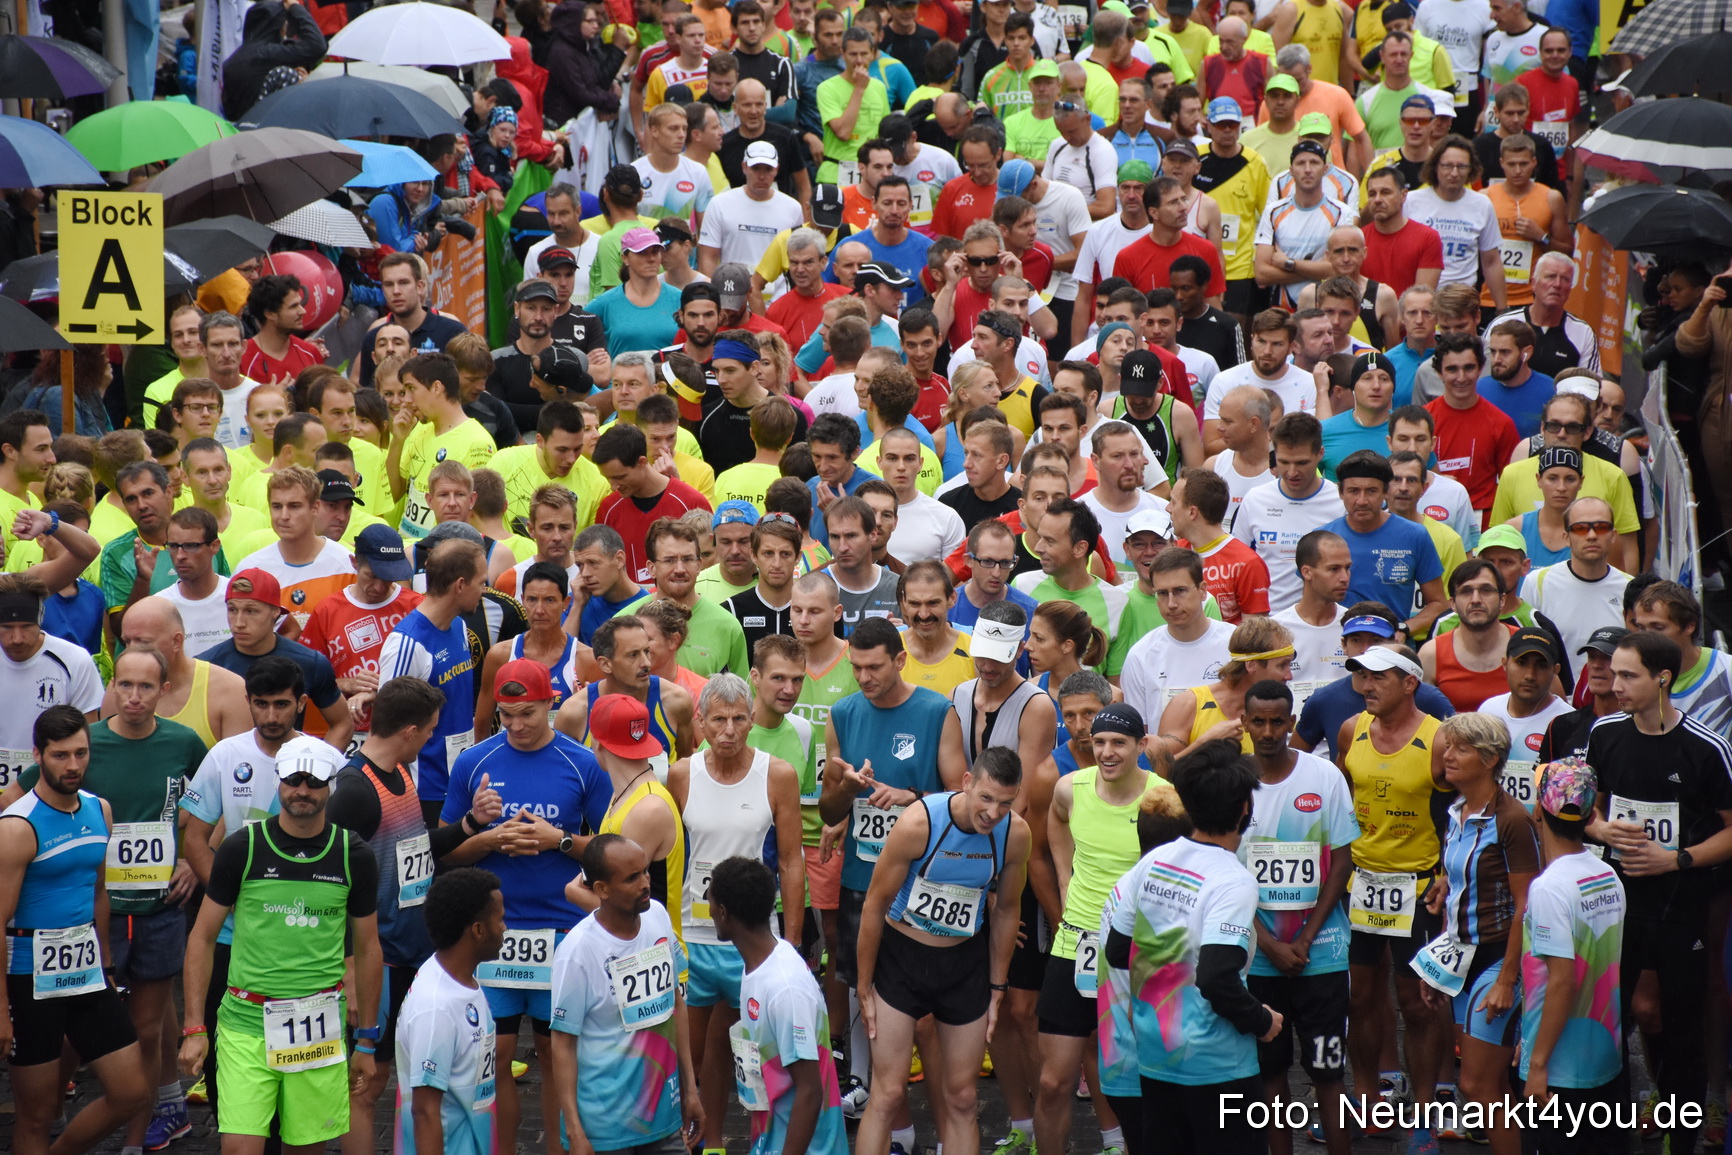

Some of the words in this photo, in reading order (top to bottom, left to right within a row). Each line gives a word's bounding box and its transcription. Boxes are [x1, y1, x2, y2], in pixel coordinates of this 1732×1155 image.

[72, 198, 153, 227] Block
[82, 238, 143, 311] A
[727, 492, 754, 503] Team
[1427, 507, 1447, 518] Hervis
[1298, 799, 1321, 808] Hervis
[118, 838, 164, 865] 620
[1279, 844, 1313, 854] BOCK
[1254, 858, 1315, 884] 2679
[1268, 890, 1301, 901] Mohad
[1363, 885, 1403, 912] 319
[263, 903, 298, 915] SoWiso
[304, 906, 323, 916] Run
[329, 908, 339, 916] Fit
[913, 892, 973, 928] 2685
[1367, 914, 1397, 927] Robert
[42, 939, 96, 973] 2673
[501, 937, 548, 963] 393
[495, 966, 535, 980] Andreas
[1424, 959, 1441, 980] Petra
[55, 974, 87, 989] Roland
[622, 961, 673, 1004] 2722
[282, 1012, 326, 1045] 111
[275, 1044, 335, 1064] FrankenBlitz
[1312, 1035, 1342, 1070] 13
